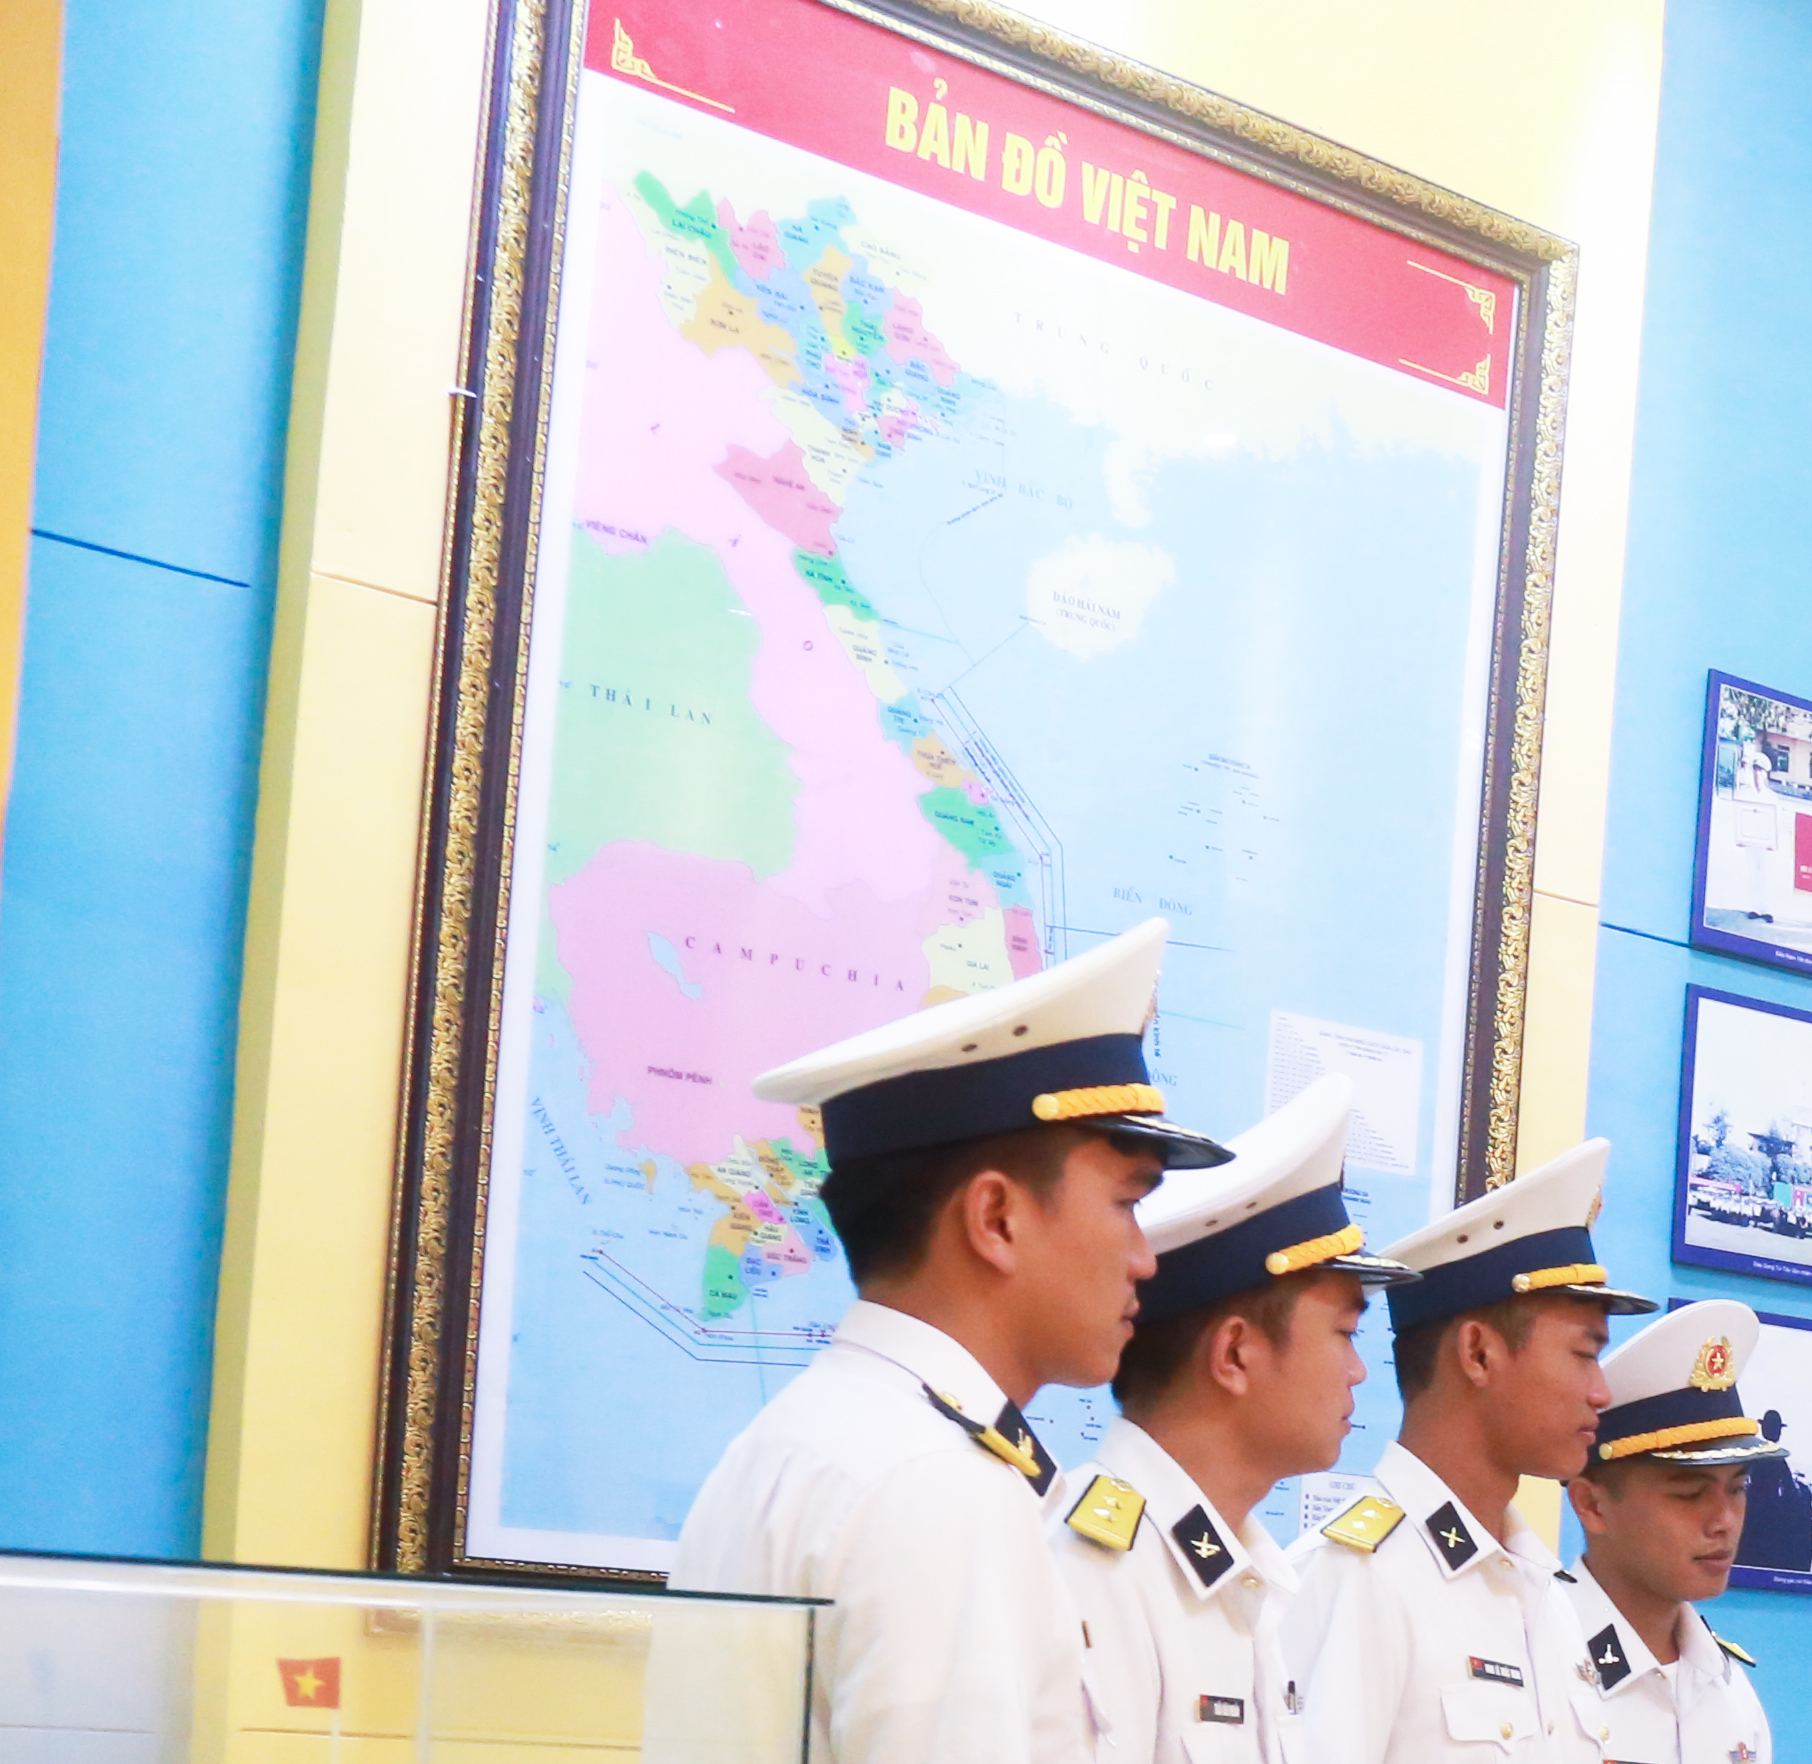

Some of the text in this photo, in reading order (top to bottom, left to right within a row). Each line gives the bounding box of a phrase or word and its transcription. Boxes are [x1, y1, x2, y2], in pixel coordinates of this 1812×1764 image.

[885, 76, 1290, 295] BẢN ĐỒ VIỆT NAM
[1014, 311, 1214, 392] TRUNG QUỐC
[1098, 604, 1122, 621] NAM
[589, 682, 713, 726] THÁI LAN
[1112, 884, 1193, 916] BIỂN ĐÔNG
[685, 935, 905, 992] CAMPUCHIA
